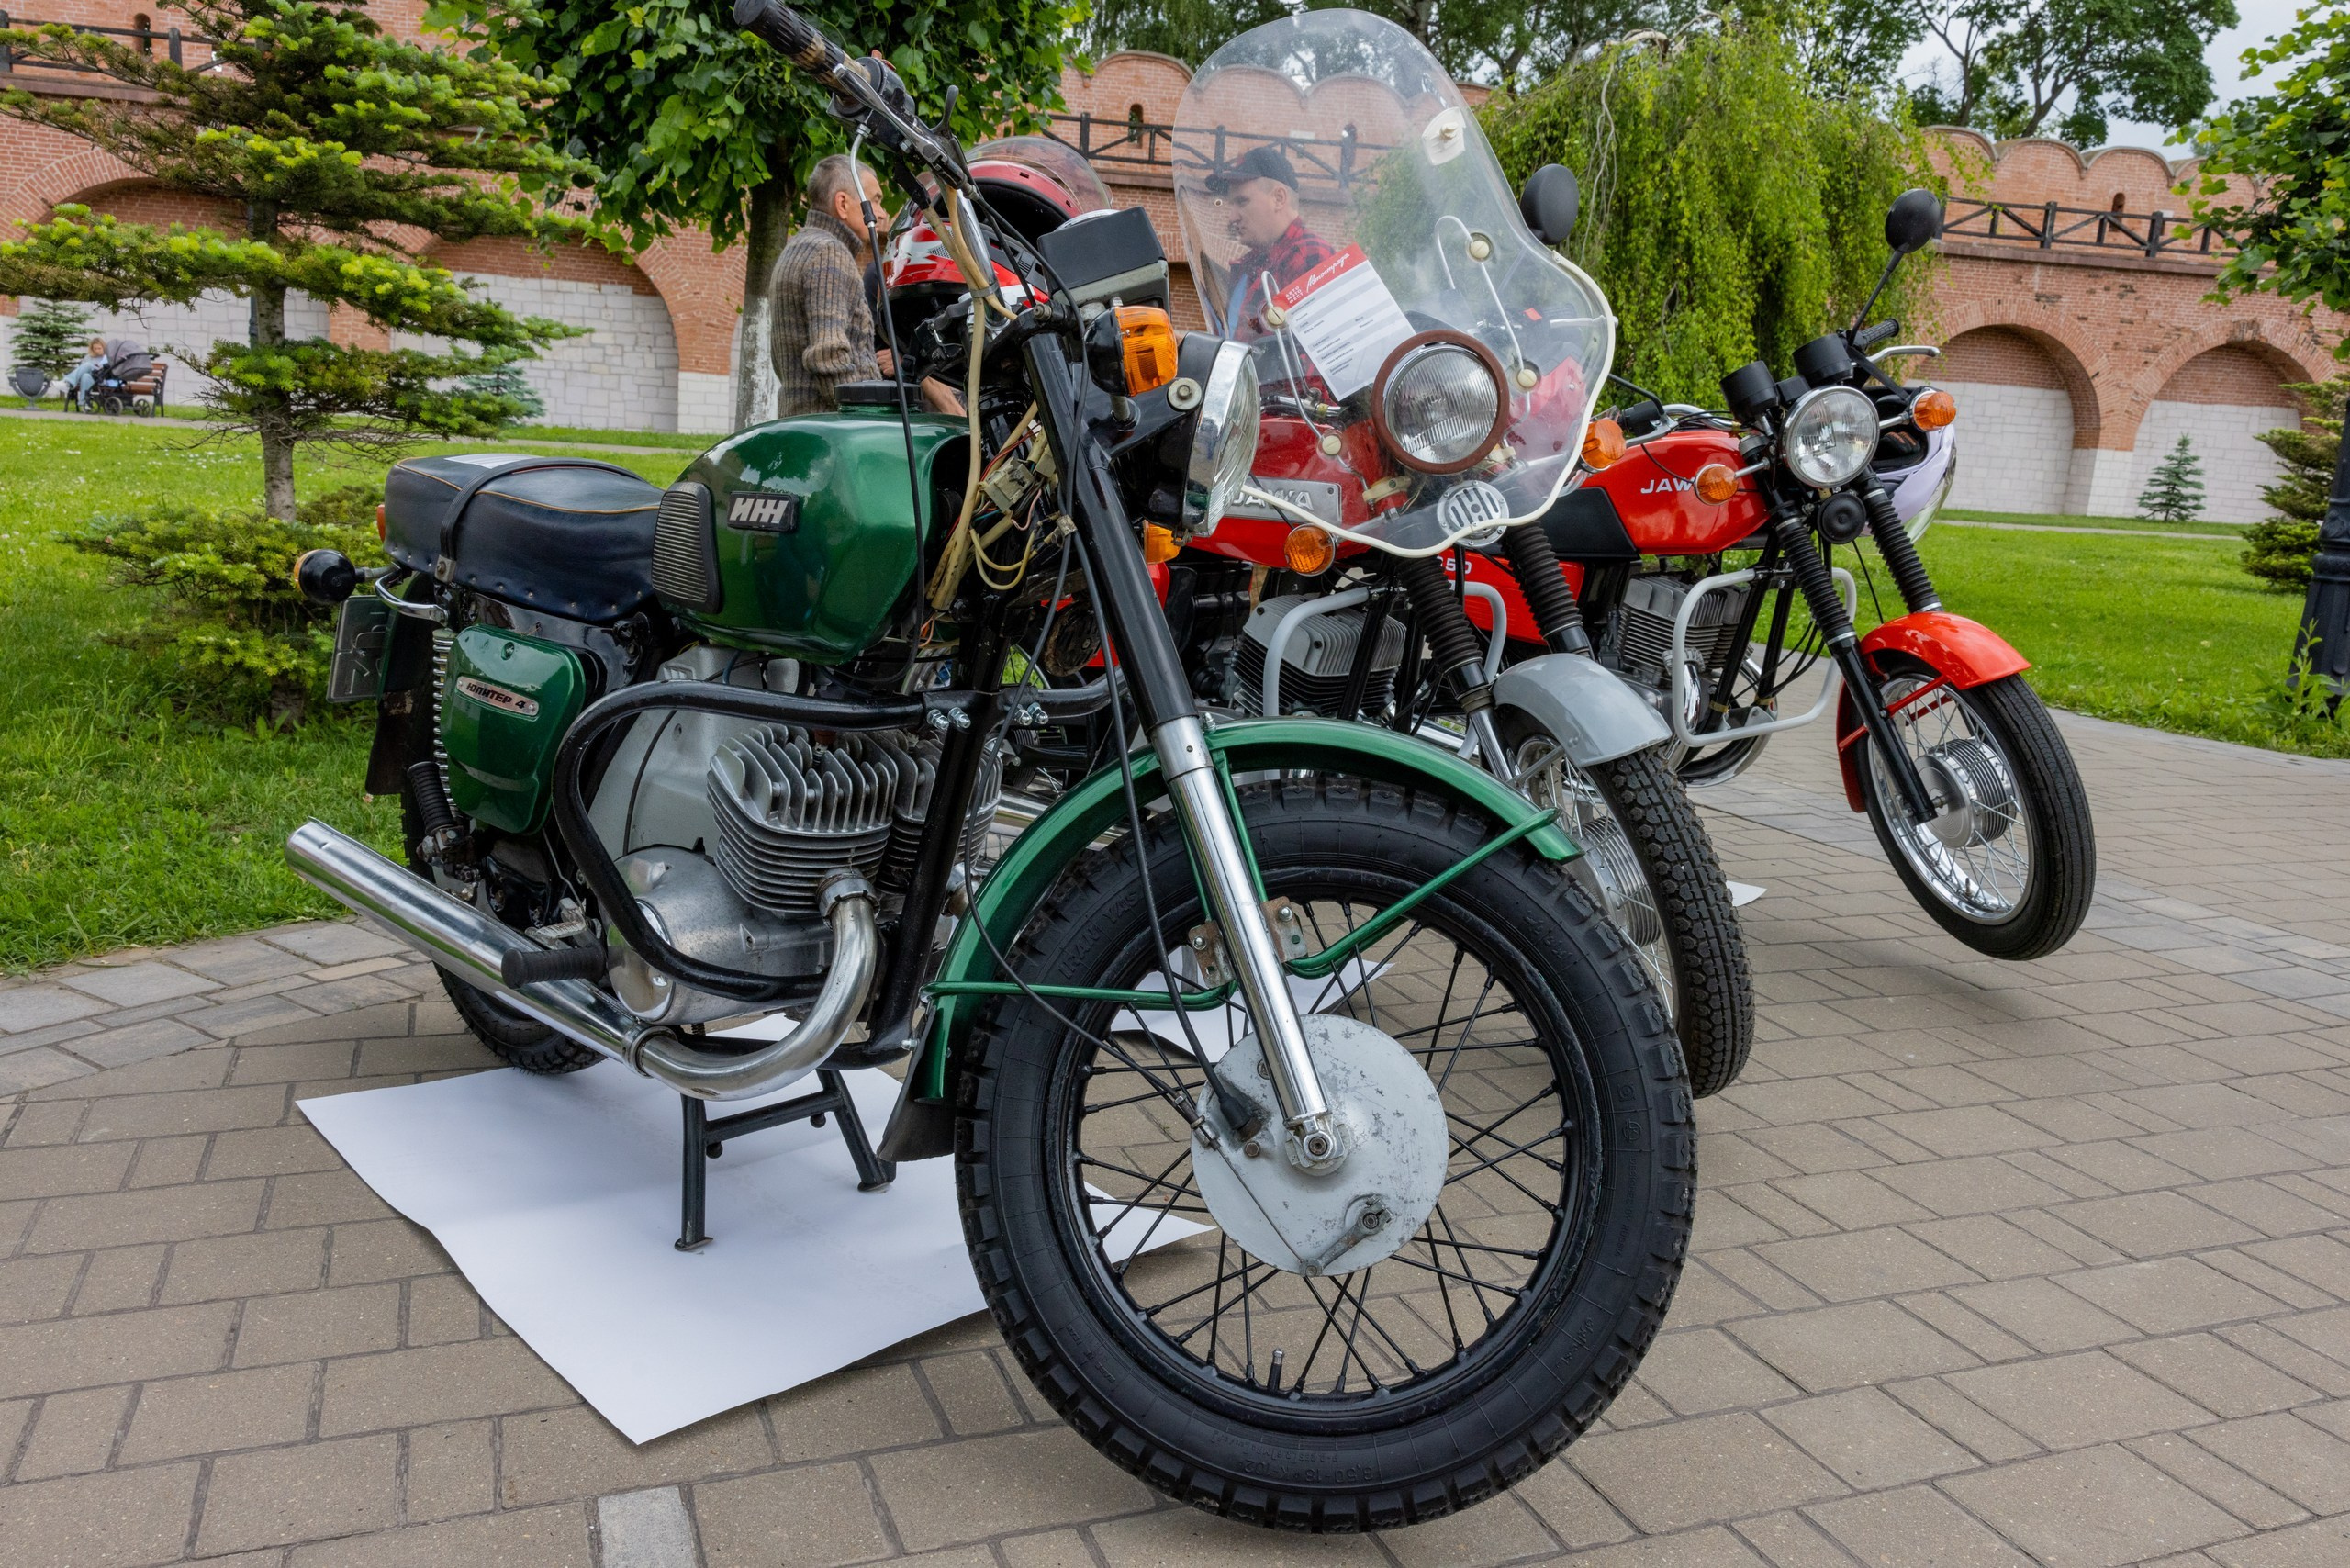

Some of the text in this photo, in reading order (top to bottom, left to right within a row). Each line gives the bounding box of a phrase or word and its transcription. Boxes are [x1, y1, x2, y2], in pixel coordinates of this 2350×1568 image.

[1640, 476, 1696, 494] JAW
[466, 682, 526, 709] ЮПИТЕР 4
